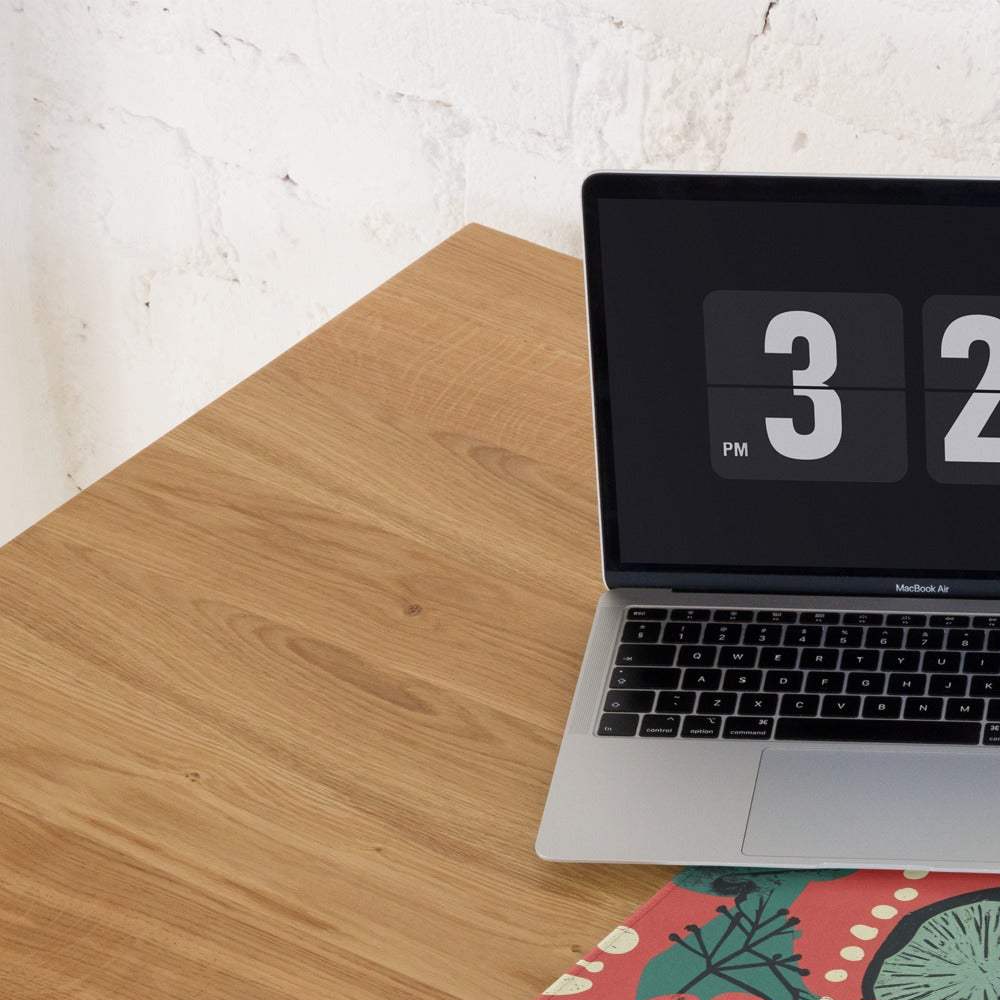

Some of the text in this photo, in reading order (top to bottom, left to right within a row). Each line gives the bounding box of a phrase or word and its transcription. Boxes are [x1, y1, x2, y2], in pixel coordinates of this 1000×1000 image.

[764, 310, 842, 460] 3
[723, 442, 748, 458] PM
[895, 583, 950, 593] MacBook Air
